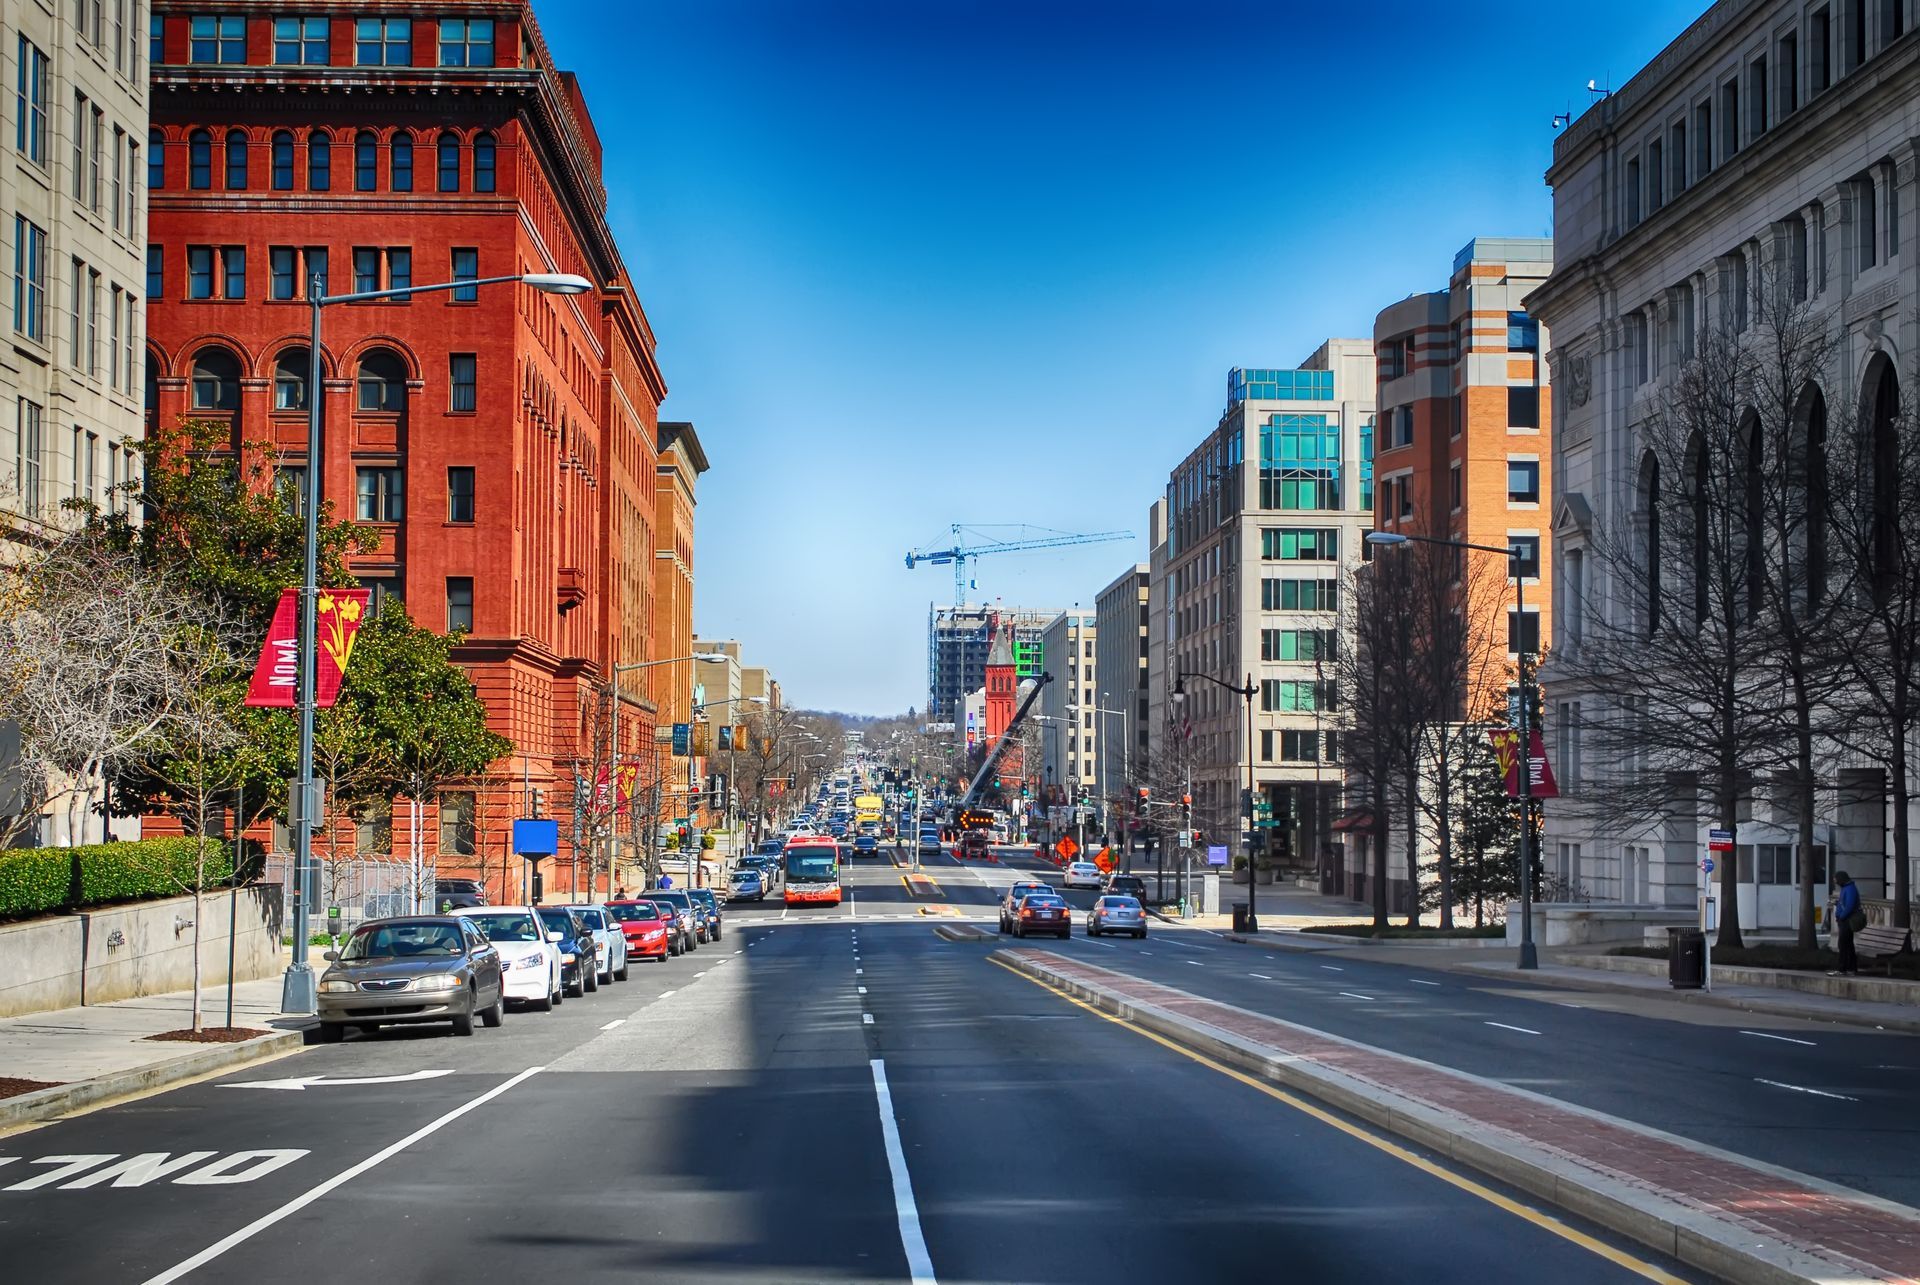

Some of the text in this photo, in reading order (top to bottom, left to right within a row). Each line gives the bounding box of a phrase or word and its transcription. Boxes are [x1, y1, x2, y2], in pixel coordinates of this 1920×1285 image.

[269, 638, 298, 686] NOMA
[1529, 757, 1545, 785] NOMA
[0, 1149, 311, 1191] ONL
